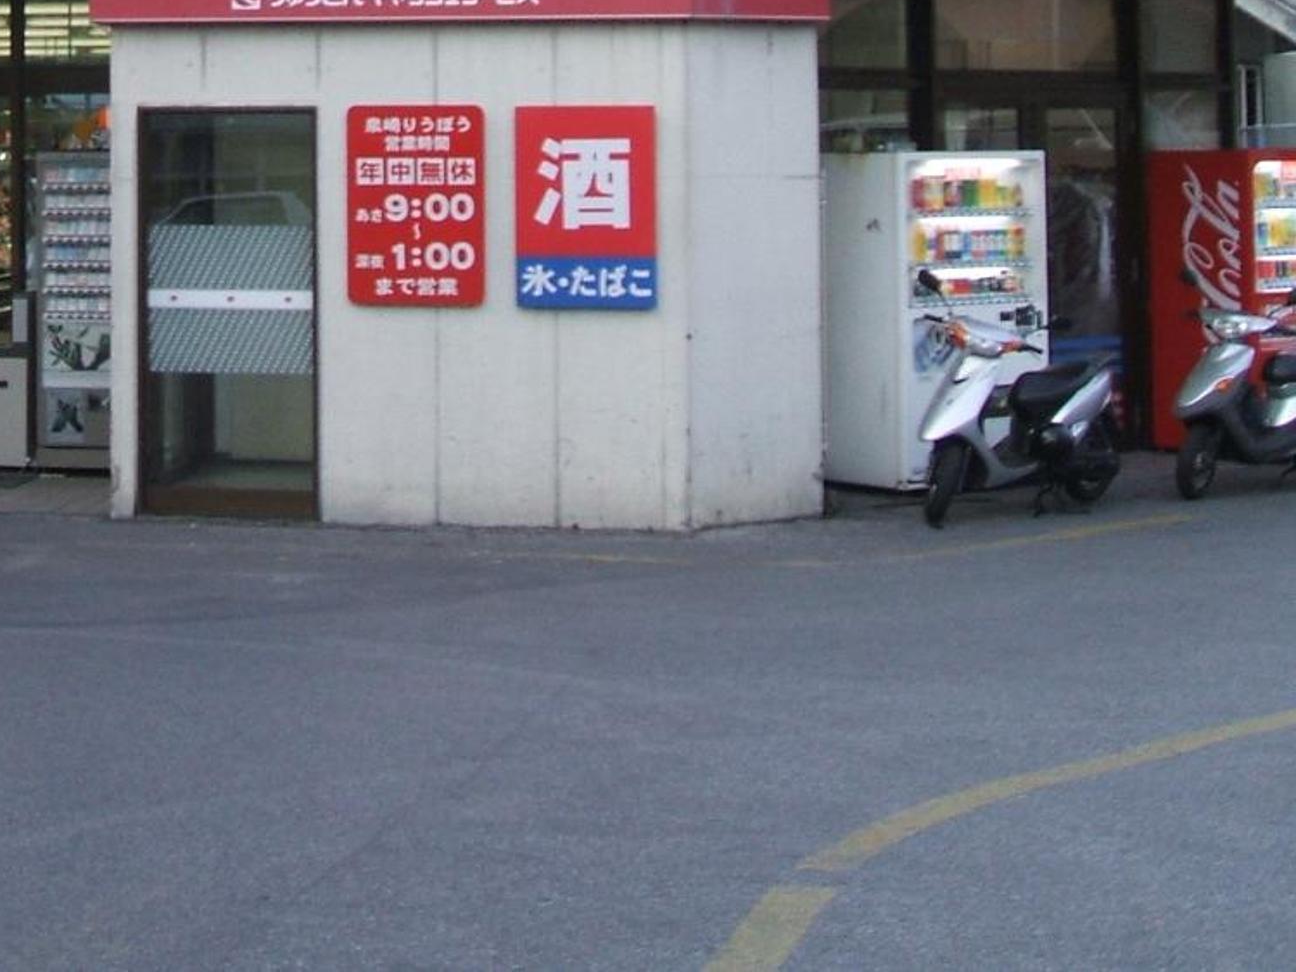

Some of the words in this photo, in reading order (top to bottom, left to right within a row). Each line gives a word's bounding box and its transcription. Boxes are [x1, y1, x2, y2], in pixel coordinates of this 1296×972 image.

[358, 159, 474, 184] 年中無休
[533, 136, 632, 231] 酒
